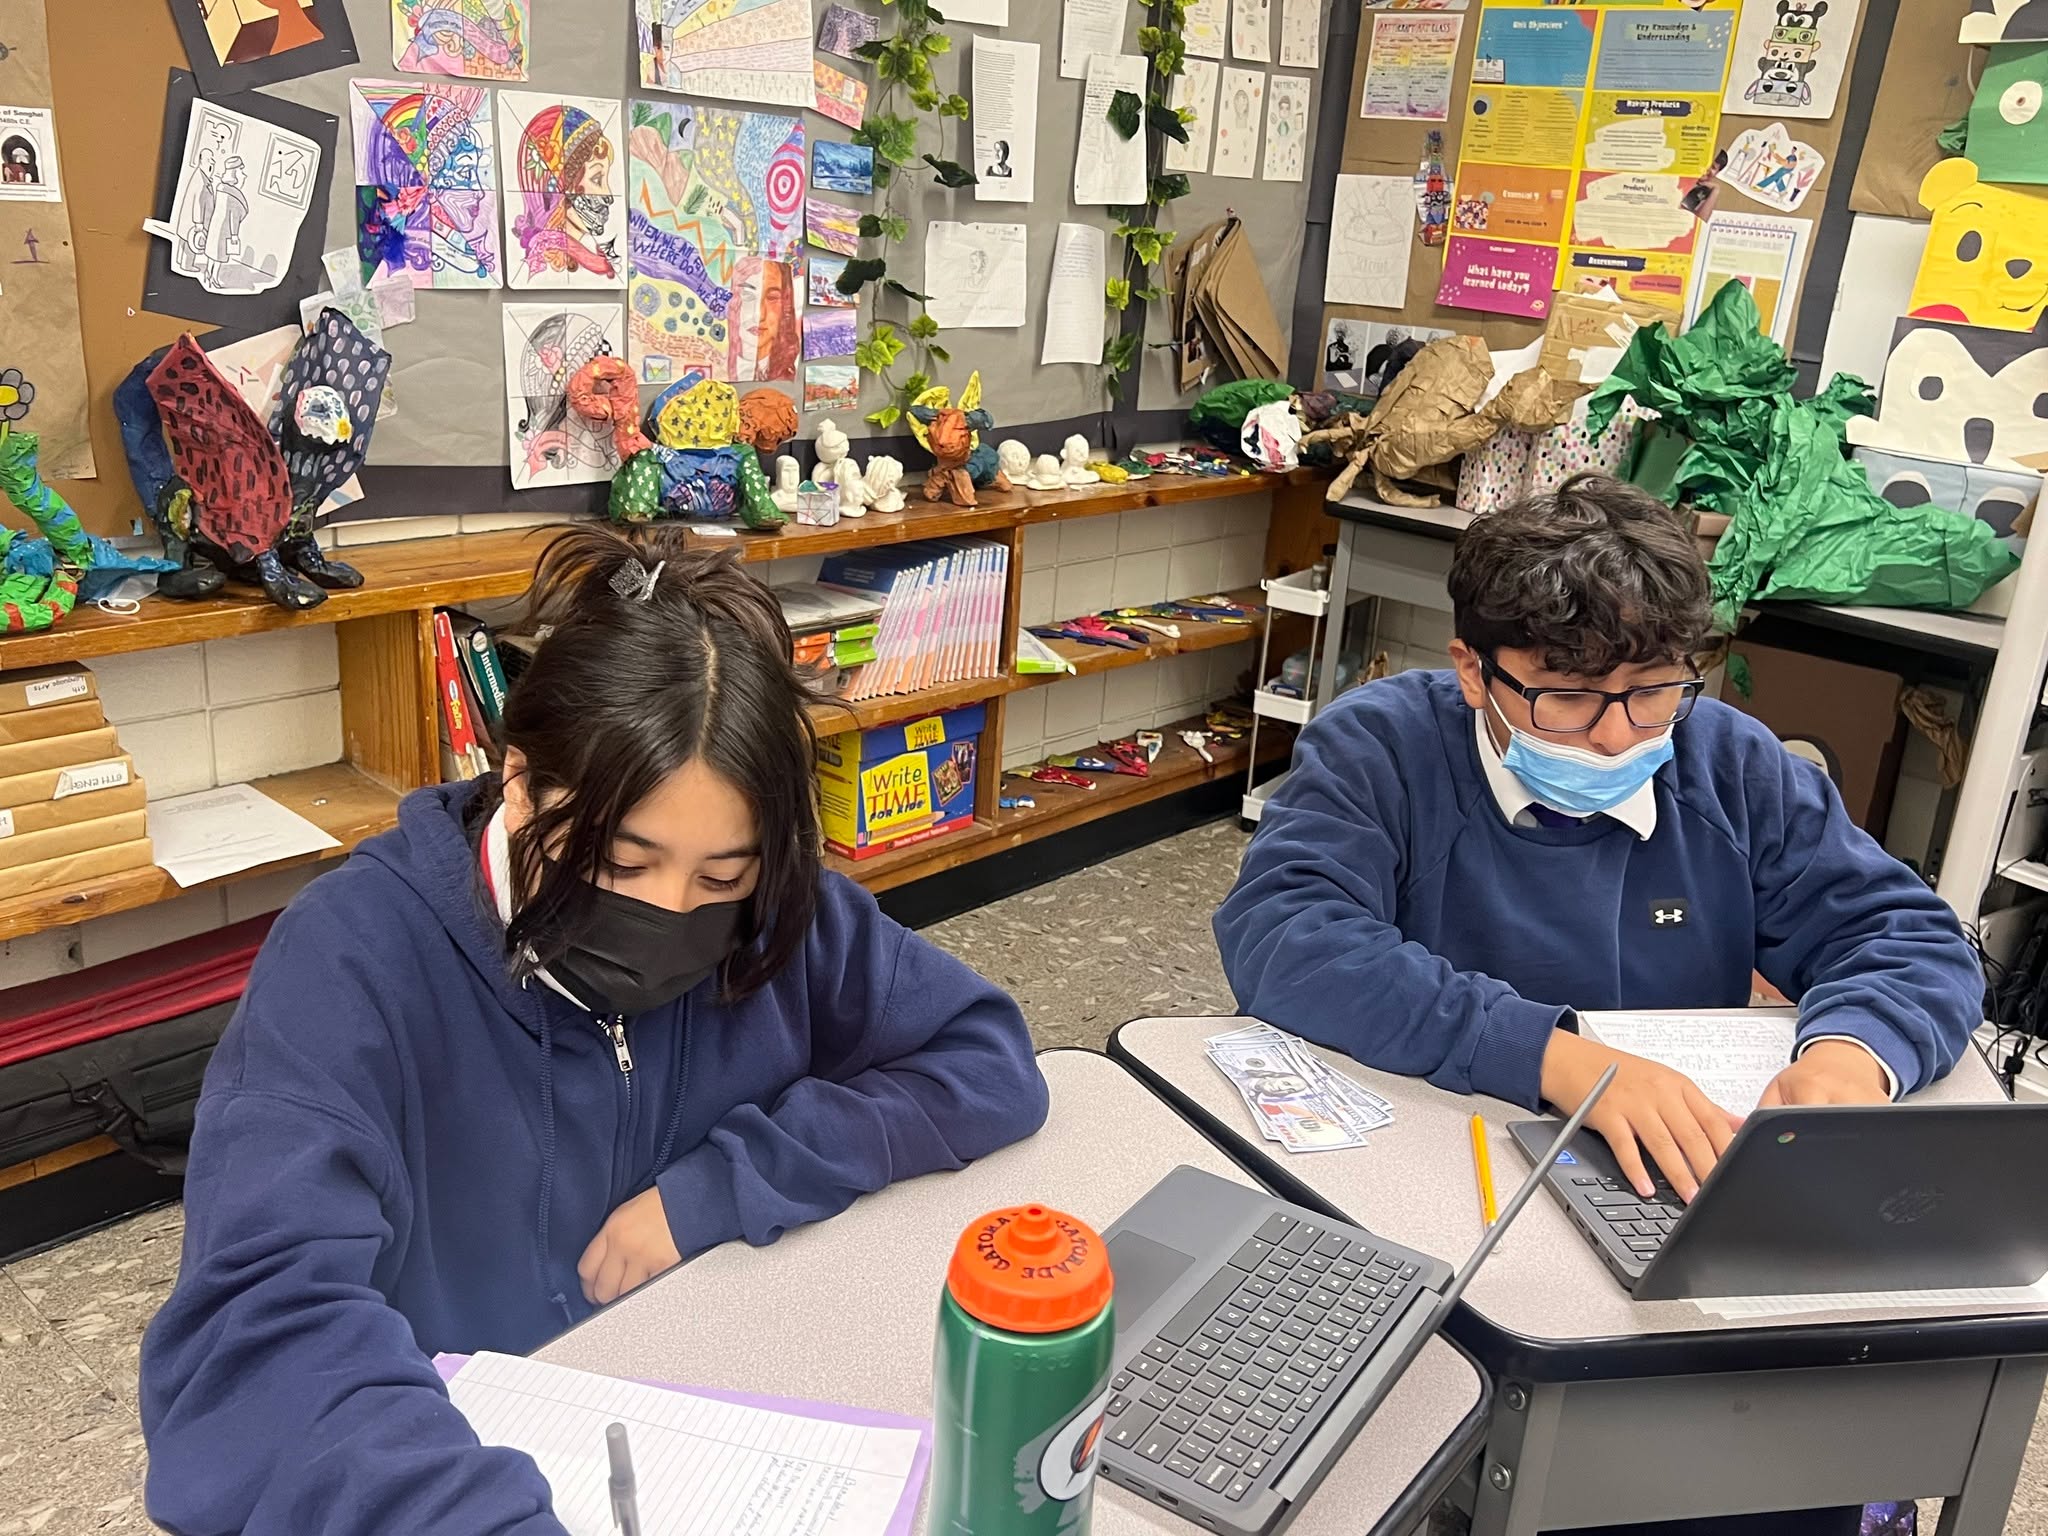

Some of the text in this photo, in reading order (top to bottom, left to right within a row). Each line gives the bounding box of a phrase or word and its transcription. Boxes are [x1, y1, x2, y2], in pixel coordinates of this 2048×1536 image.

[1636, 23, 1648, 33] Key
[1652, 23, 1688, 34] Knowledge
[1636, 34, 1691, 44] Understanding
[1651, 101, 1681, 109] Products
[630, 214, 659, 243] WHEN
[661, 233, 677, 250] WE
[633, 237, 678, 267] WHERE
[679, 259, 695, 276] DO
[695, 284, 711, 303] WE
[1467, 264, 1530, 281] What have you
[1463, 276, 1530, 296] learned today?
[913, 732, 939, 743] TIME
[914, 724, 938, 735] Write
[873, 766, 922, 793] Write
[867, 781, 927, 814] TIME
[868, 799, 925, 822] FOR KIDS
